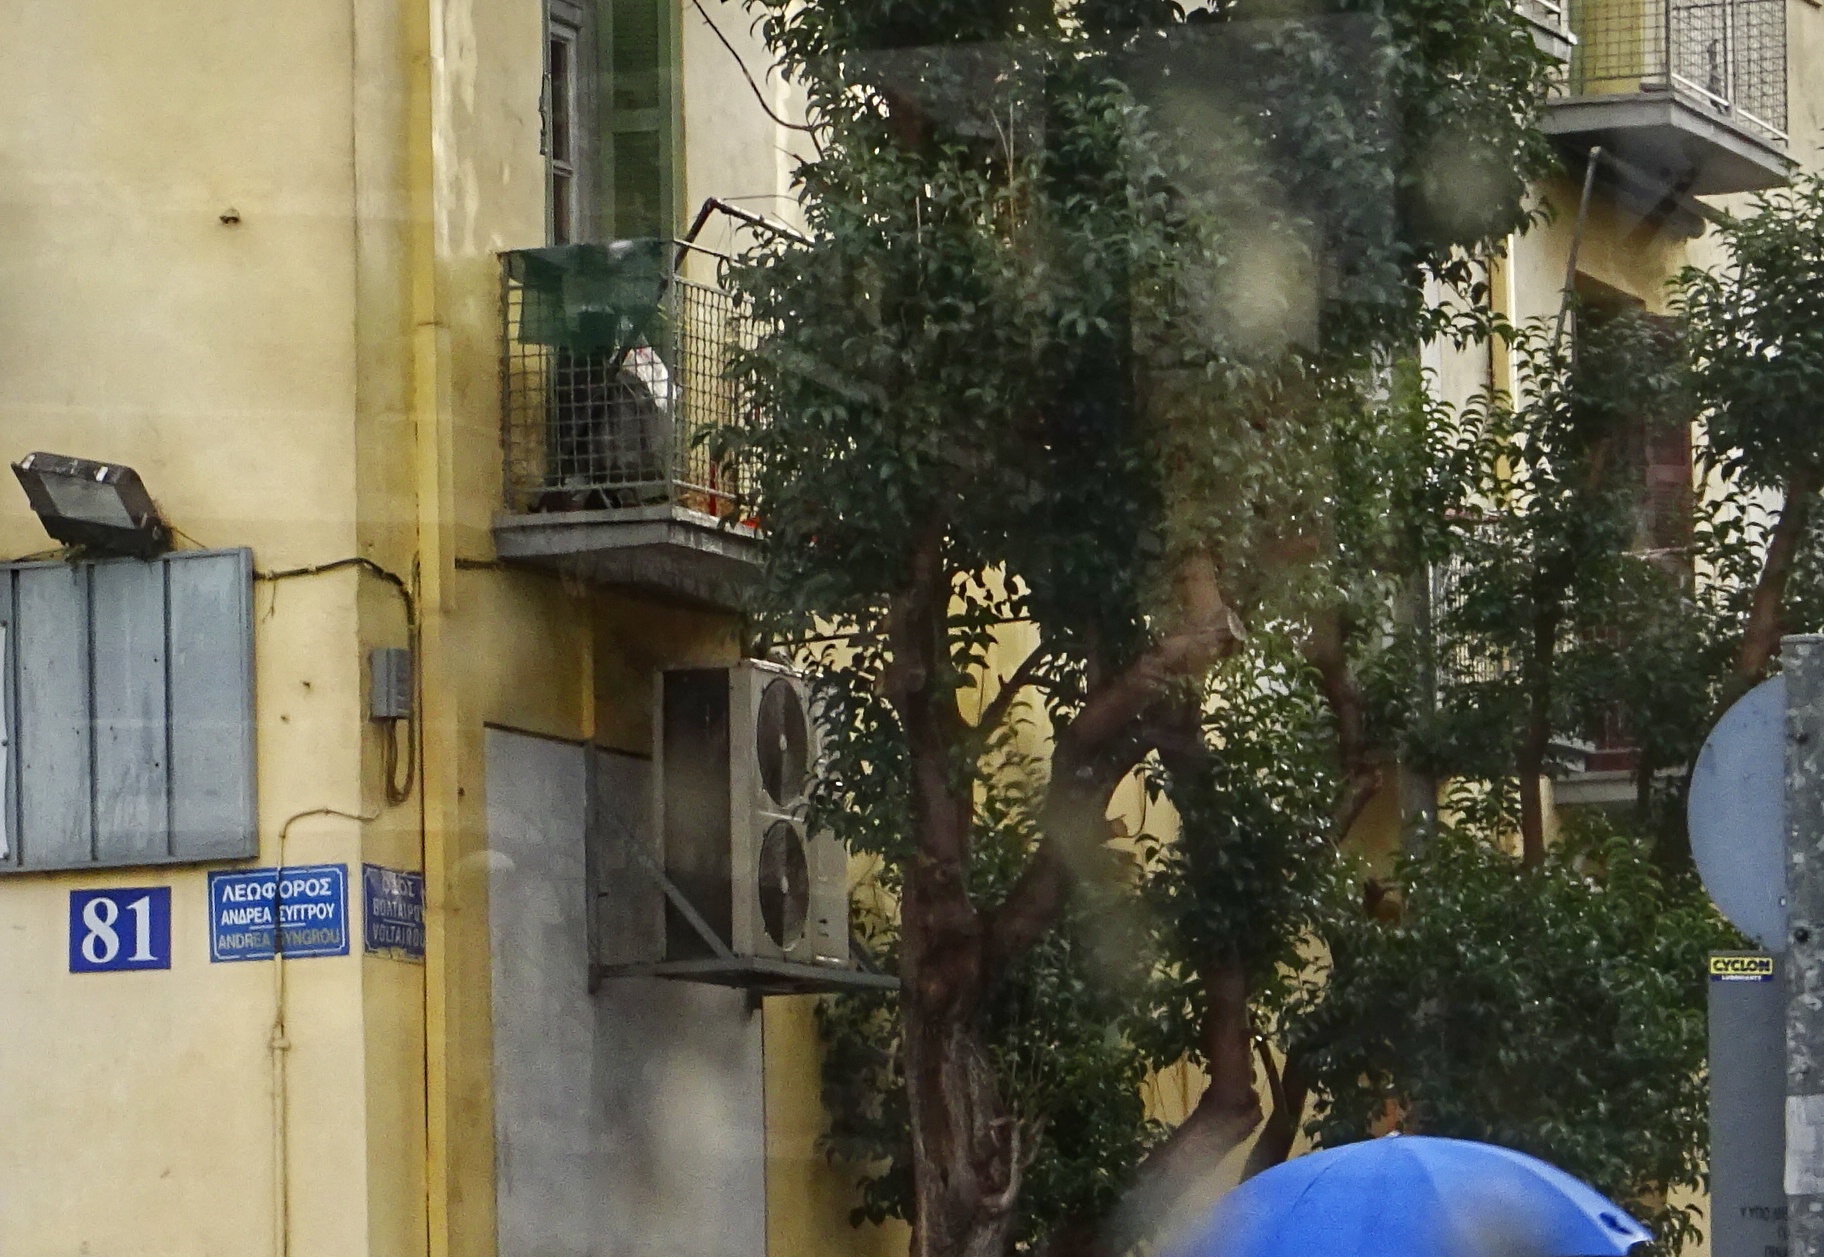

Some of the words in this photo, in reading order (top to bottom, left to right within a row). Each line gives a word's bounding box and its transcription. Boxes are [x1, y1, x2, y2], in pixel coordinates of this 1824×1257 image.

[222, 877, 332, 903] ΛΕΩΦΟΡΟΣ
[220, 907, 272, 926] ΑΝΔΡΕΑ
[279, 903, 335, 922] ΣΥΓΓΡΟΥ
[82, 896, 158, 964] 81
[218, 932, 271, 951] ANDREA
[1713, 960, 1771, 972] CYCLON
